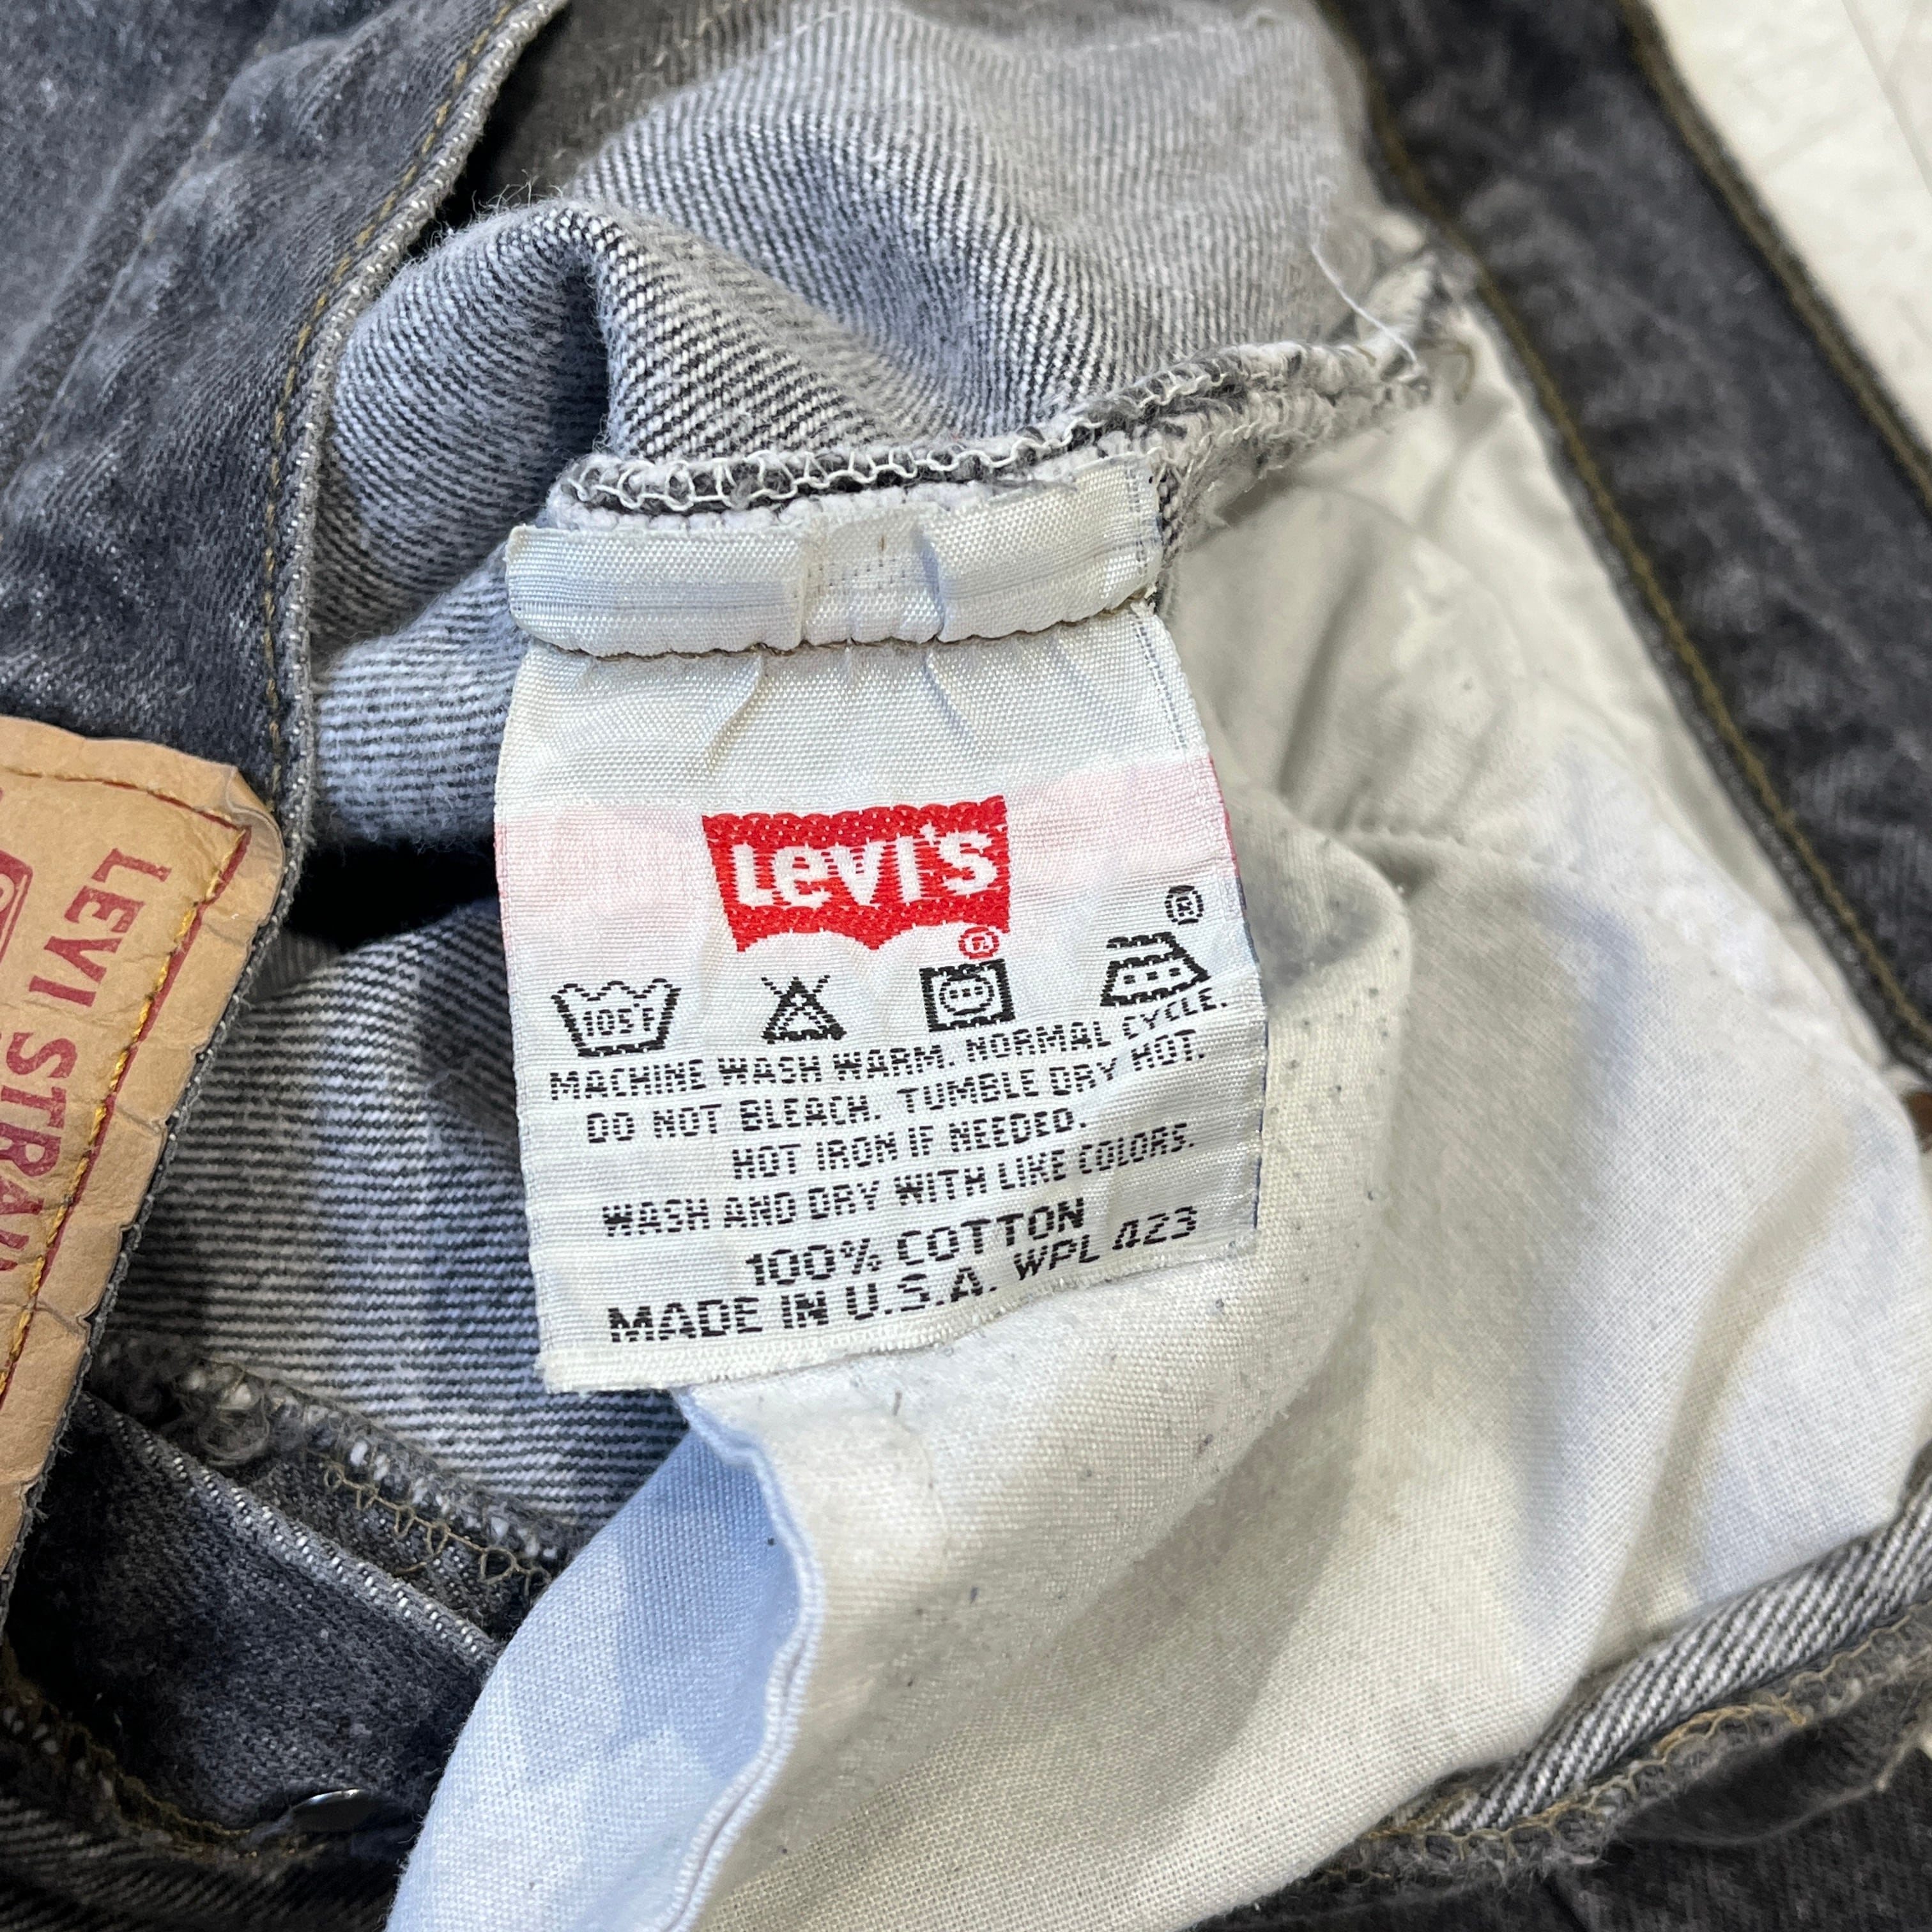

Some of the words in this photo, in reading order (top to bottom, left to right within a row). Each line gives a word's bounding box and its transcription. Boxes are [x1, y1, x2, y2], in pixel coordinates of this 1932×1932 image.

[732, 823, 997, 908] Levi's
[29, 848, 172, 1008] LEVI
[550, 1059, 706, 1100] MACHINE
[717, 1055, 822, 1085] WASH
[833, 1044, 954, 1080] WARM.
[967, 1021, 1110, 1062] NORMAL
[1123, 988, 1227, 1039] CYCLE.
[587, 1112, 635, 1143] DO
[654, 1104, 722, 1138] NOT
[740, 1094, 881, 1131] BLEACH.
[896, 1068, 1039, 1112] TUMBLE
[1050, 1058, 1117, 1096] DRY
[1131, 1029, 1204, 1071] HOT.
[602, 1199, 709, 1236] WASH
[724, 1192, 797, 1228] AND
[808, 1181, 880, 1219] DRY
[895, 1167, 986, 1206] WITH
[998, 1150, 1066, 1189] LIKE
[1078, 1123, 1194, 1174] COLORS.
[732, 1144, 801, 1179] HOT
[816, 1131, 897, 1171] IRON
[908, 1125, 933, 1156] IF
[949, 1108, 1086, 1152] NEEDED.
[608, 1296, 763, 1343] MADE
[781, 1291, 829, 1329] IN
[846, 1267, 997, 1320] U.S.A.
[1014, 1235, 1100, 1280] WPL
[746, 1238, 882, 1286] 100%
[897, 1197, 1085, 1265] COTTON
